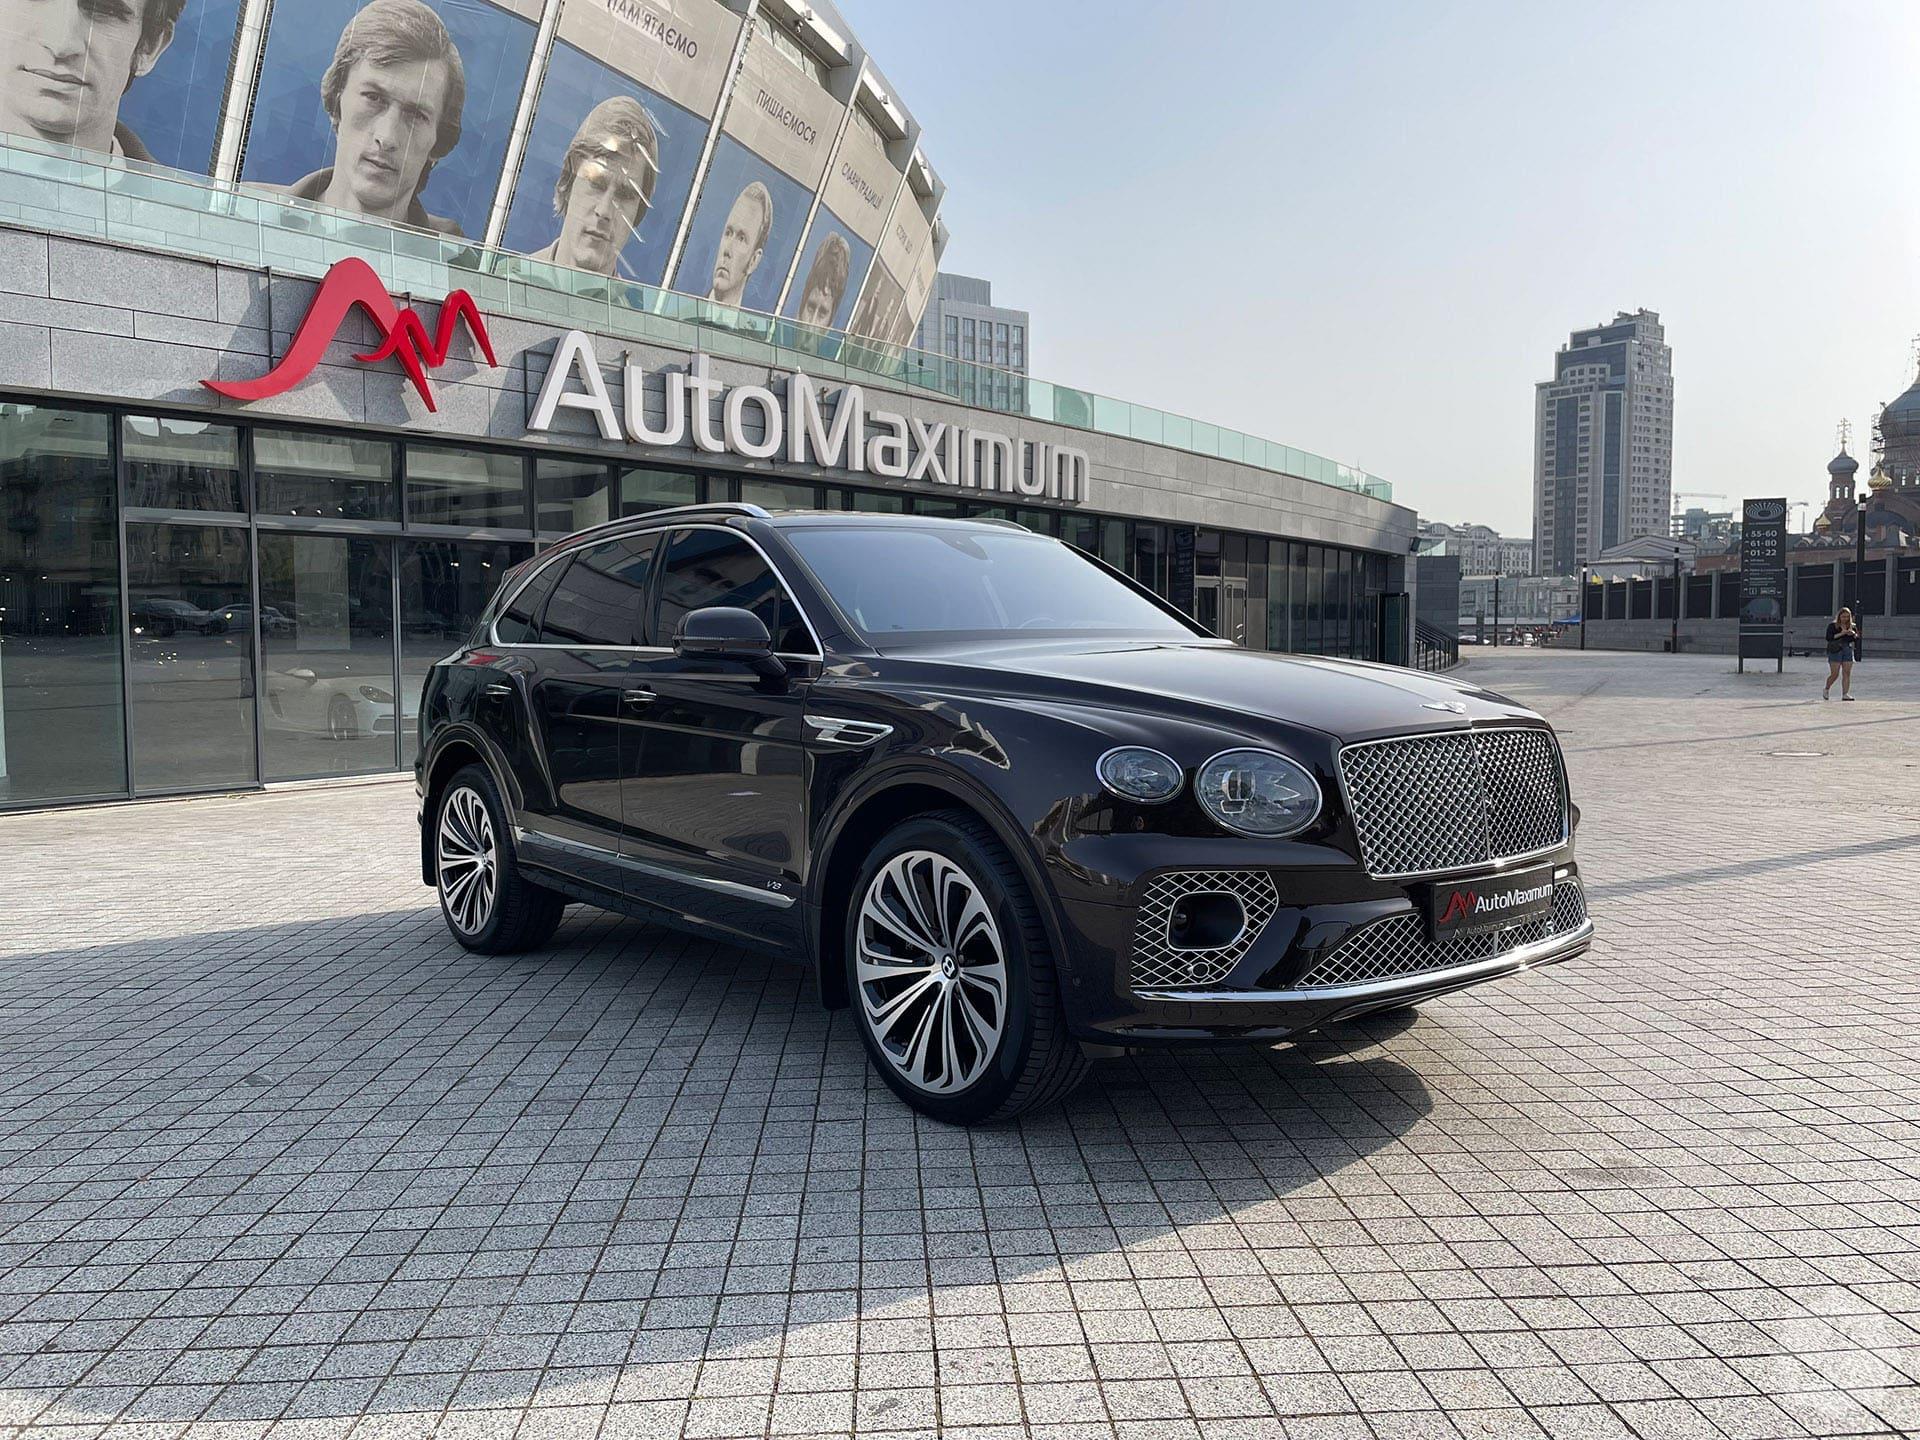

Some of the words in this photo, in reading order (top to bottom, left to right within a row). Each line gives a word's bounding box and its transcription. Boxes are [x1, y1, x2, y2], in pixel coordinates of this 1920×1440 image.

[756, 88, 816, 145] ПИШАЄМОСЯ
[527, 330, 1090, 502] AutoMaximum
[1474, 883, 1553, 913] AutoMaximum
